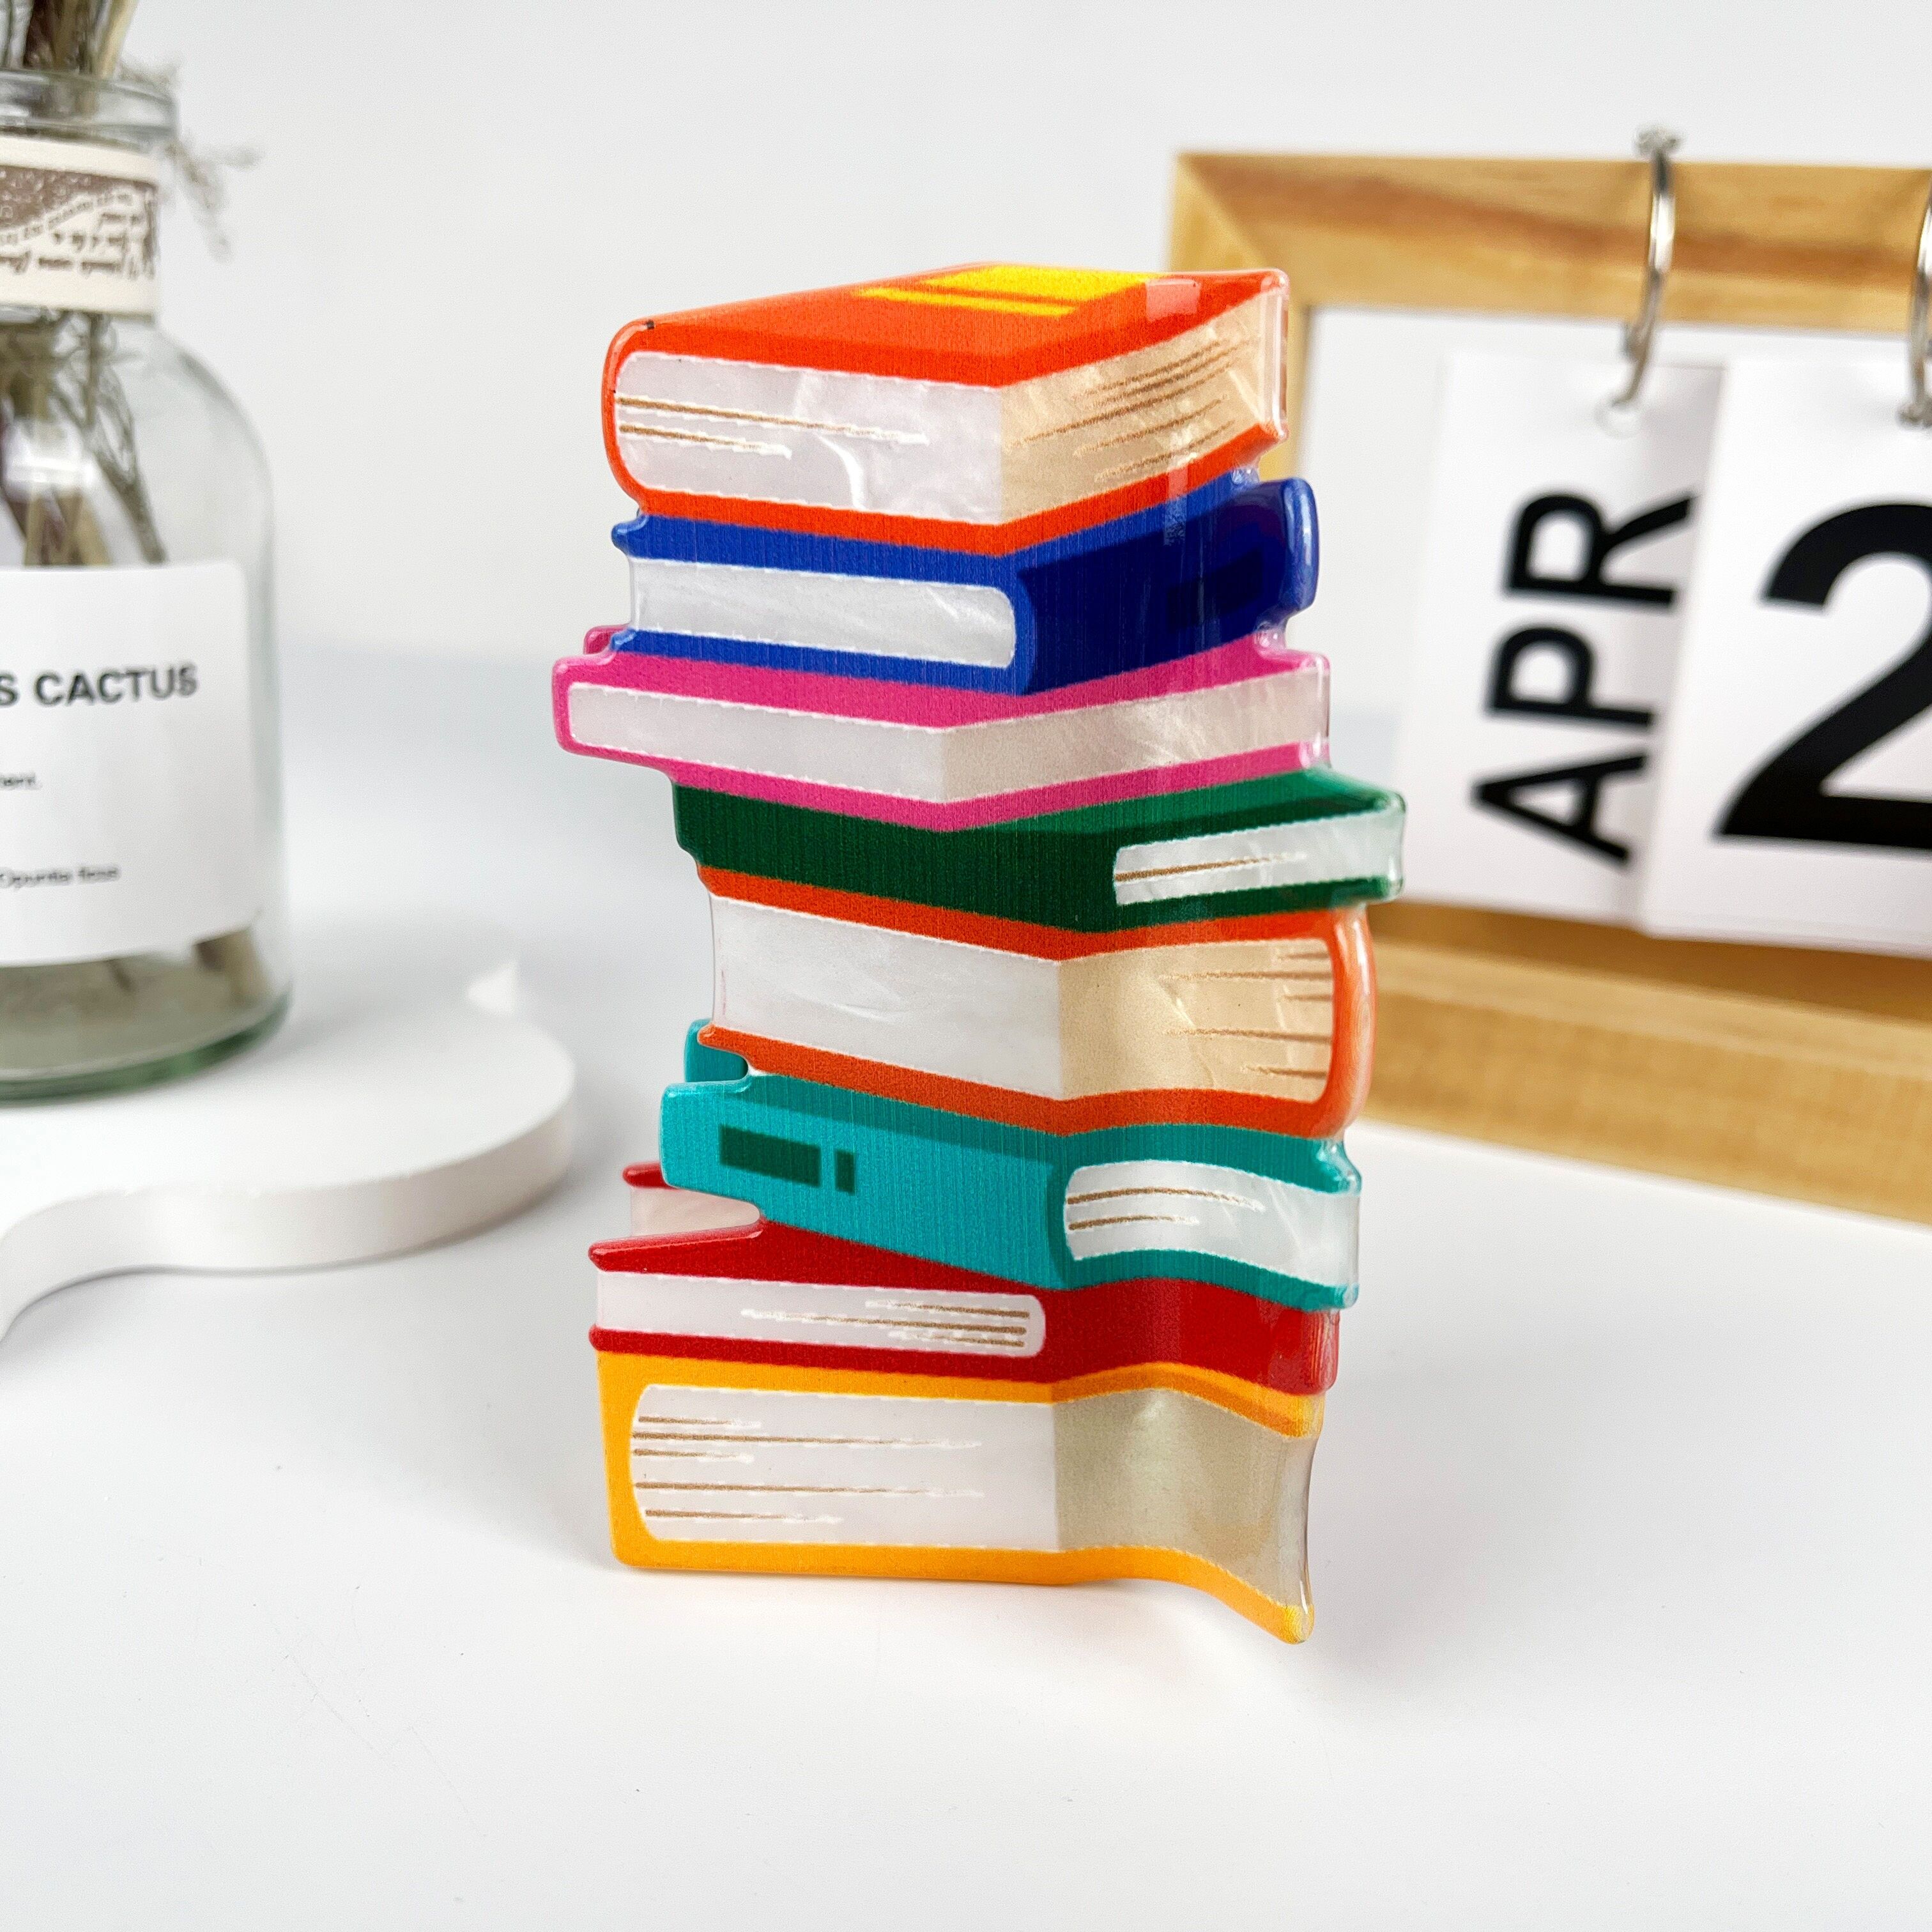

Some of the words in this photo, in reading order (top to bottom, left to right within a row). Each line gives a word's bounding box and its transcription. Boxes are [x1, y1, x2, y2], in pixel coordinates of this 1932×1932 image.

[33, 662, 198, 705] CACTUS
[1471, 491, 1697, 871] APR
[1713, 502, 1932, 859] 2
